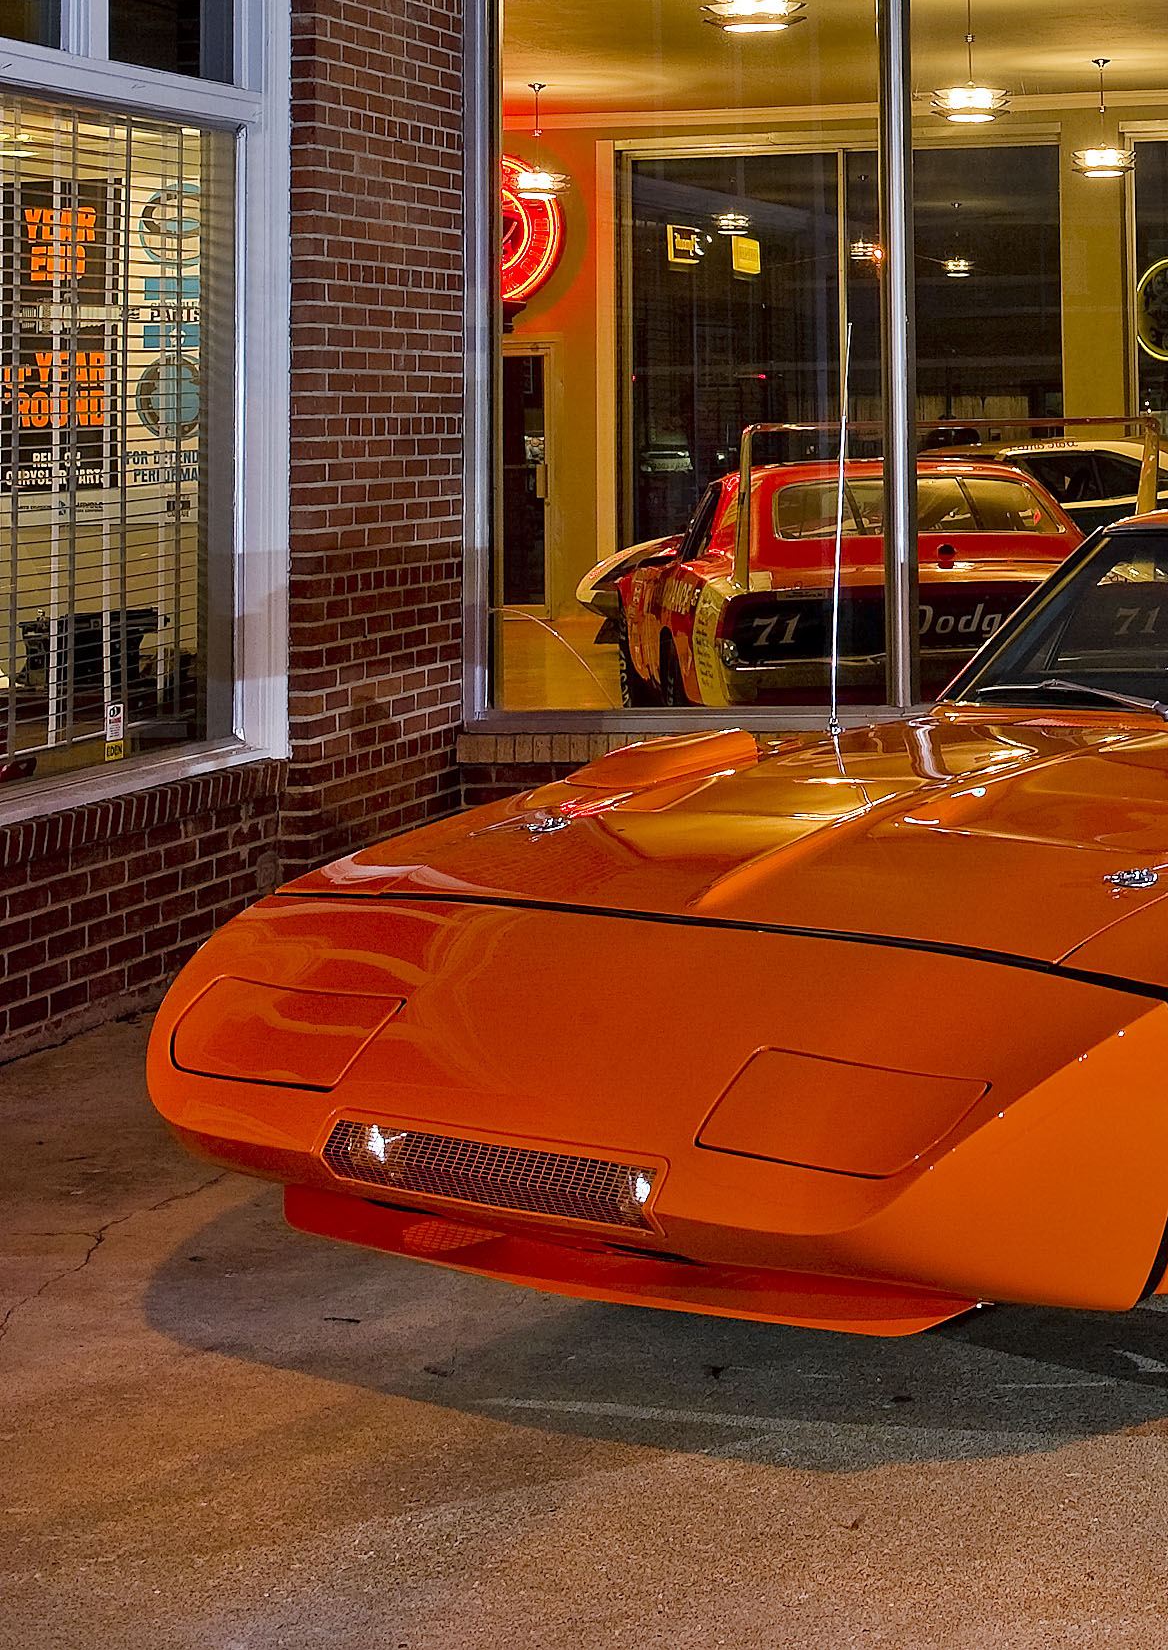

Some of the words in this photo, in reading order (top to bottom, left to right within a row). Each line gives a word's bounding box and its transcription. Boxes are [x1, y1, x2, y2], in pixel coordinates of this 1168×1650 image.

[24, 206, 97, 243] YEAR
[35, 351, 106, 388] YEAR
[126, 450, 149, 465] FOR
[752, 613, 801, 647] 71
[918, 602, 1011, 638] Dodg
[1113, 606, 1162, 636] 71
